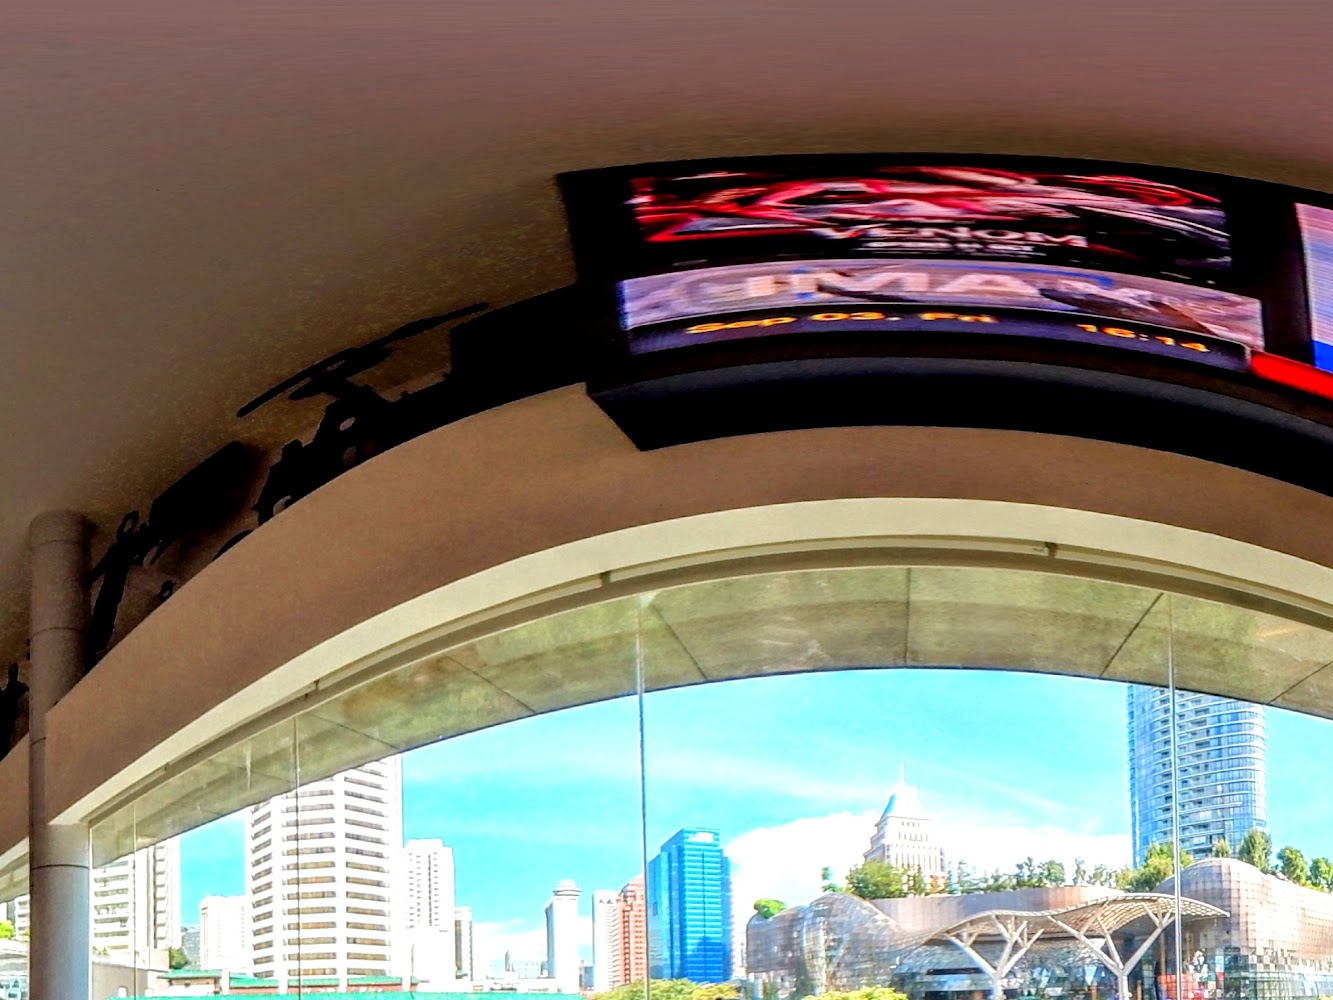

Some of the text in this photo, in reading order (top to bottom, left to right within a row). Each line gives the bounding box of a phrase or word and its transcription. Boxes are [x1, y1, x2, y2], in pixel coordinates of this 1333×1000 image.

[808, 224, 1089, 247] VENOM
[686, 314, 797, 334] Sep
[1076, 323, 1210, 352] 16:14
